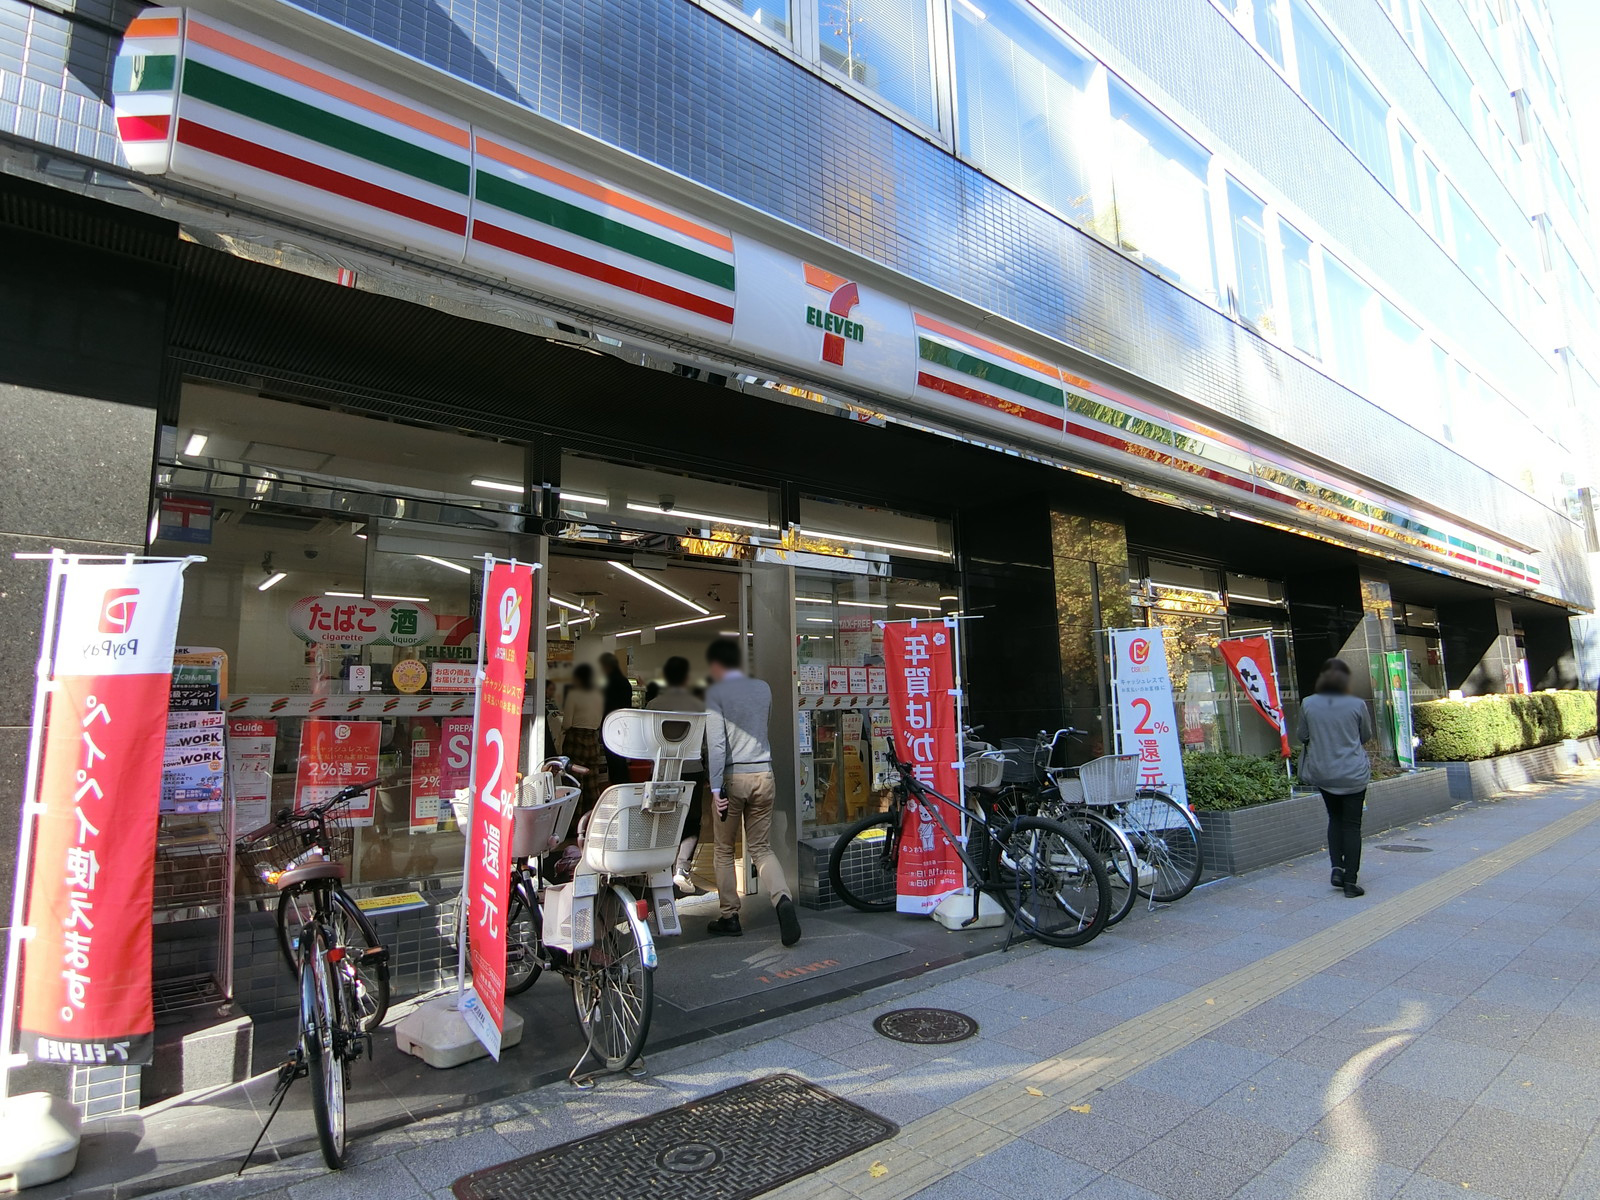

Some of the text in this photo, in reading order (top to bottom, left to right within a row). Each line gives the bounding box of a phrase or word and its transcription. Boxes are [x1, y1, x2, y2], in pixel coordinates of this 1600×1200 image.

[309, 603, 377, 632] たばこ
[390, 608, 418, 635] 酒
[322, 633, 363, 641] cigarette
[392, 635, 418, 643] liquor
[435, 668, 471, 676] お店の商品
[1121, 677, 1165, 685] キャッシュレスで
[234, 723, 263, 732] Guide
[180, 732, 222, 746] WORK
[181, 750, 223, 765] WORK
[308, 762, 369, 776] 2%還元
